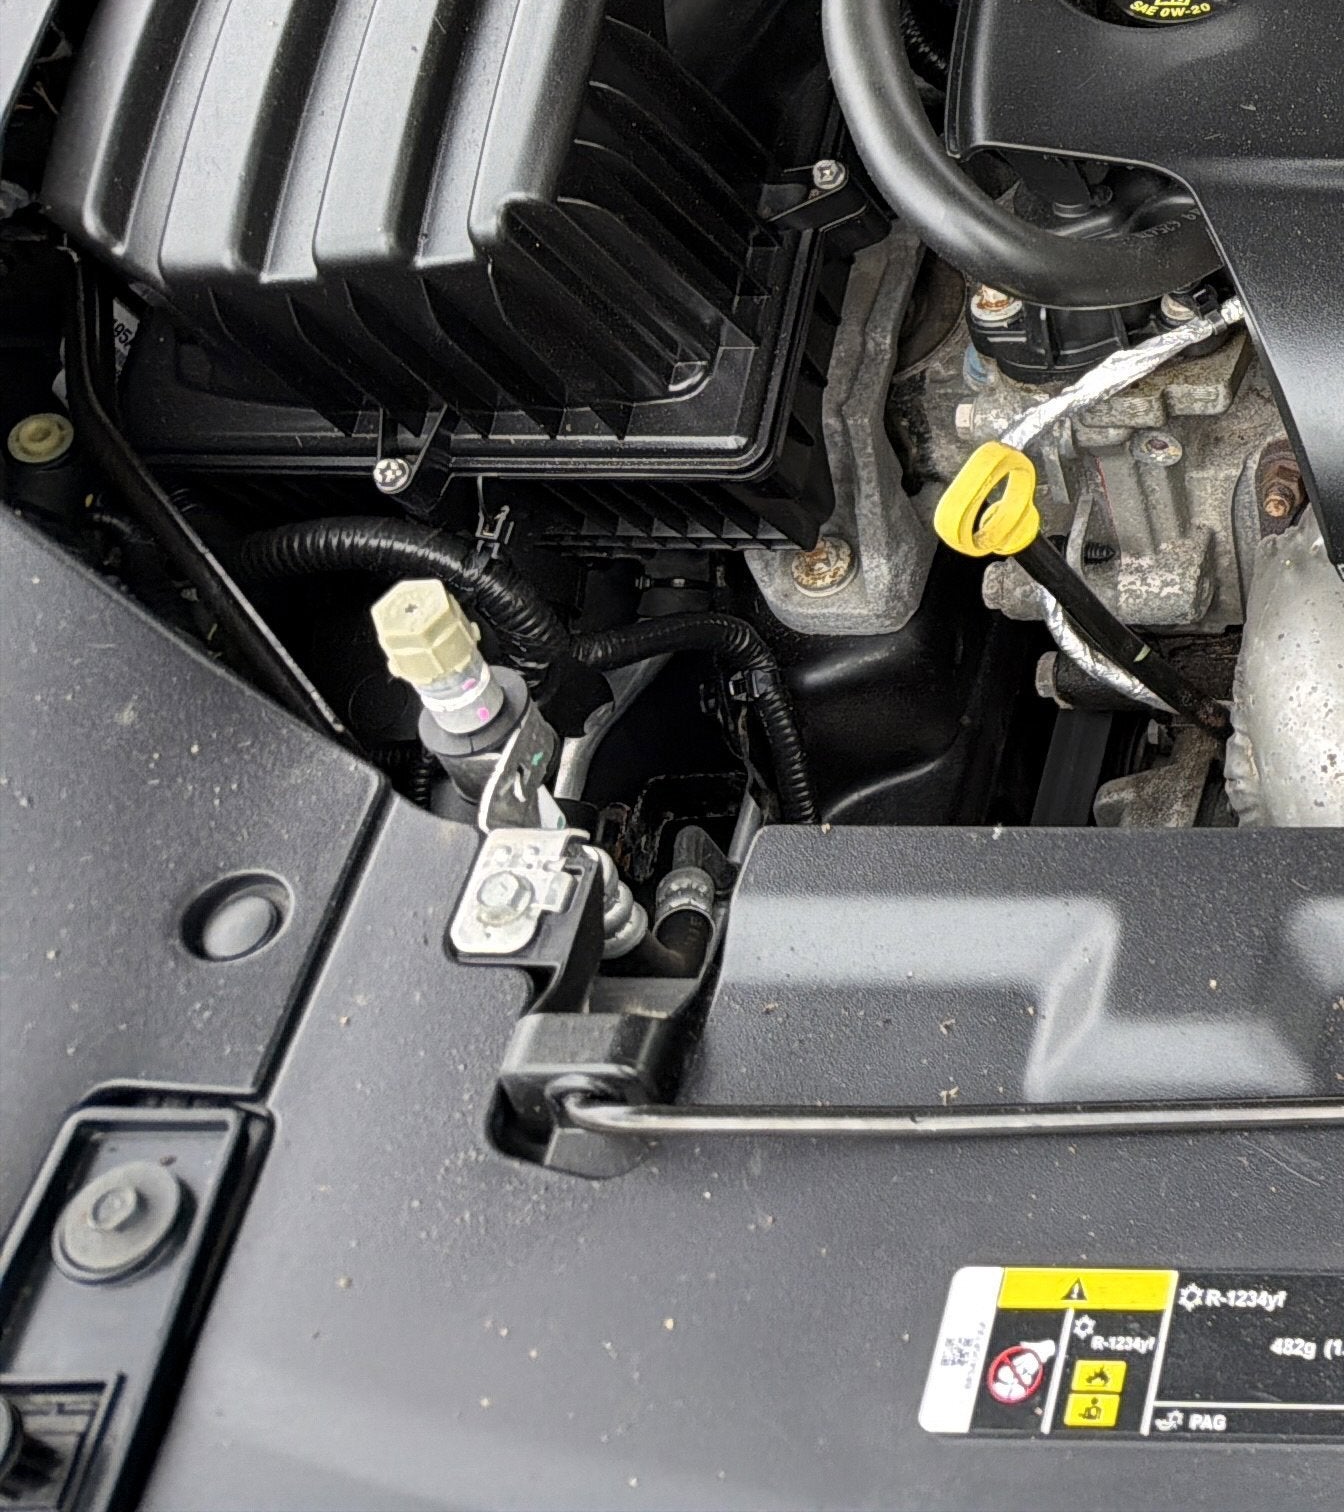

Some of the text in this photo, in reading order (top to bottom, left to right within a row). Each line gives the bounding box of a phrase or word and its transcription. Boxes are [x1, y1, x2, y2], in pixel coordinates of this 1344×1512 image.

[1130, 0, 1211, 18] SAE 0W-20
[1205, 1289, 1287, 1310] R-1234yf
[1091, 1334, 1156, 1353] R-1234yf
[1270, 1338, 1317, 1360] 482g
[1188, 1413, 1227, 1431] PAG
